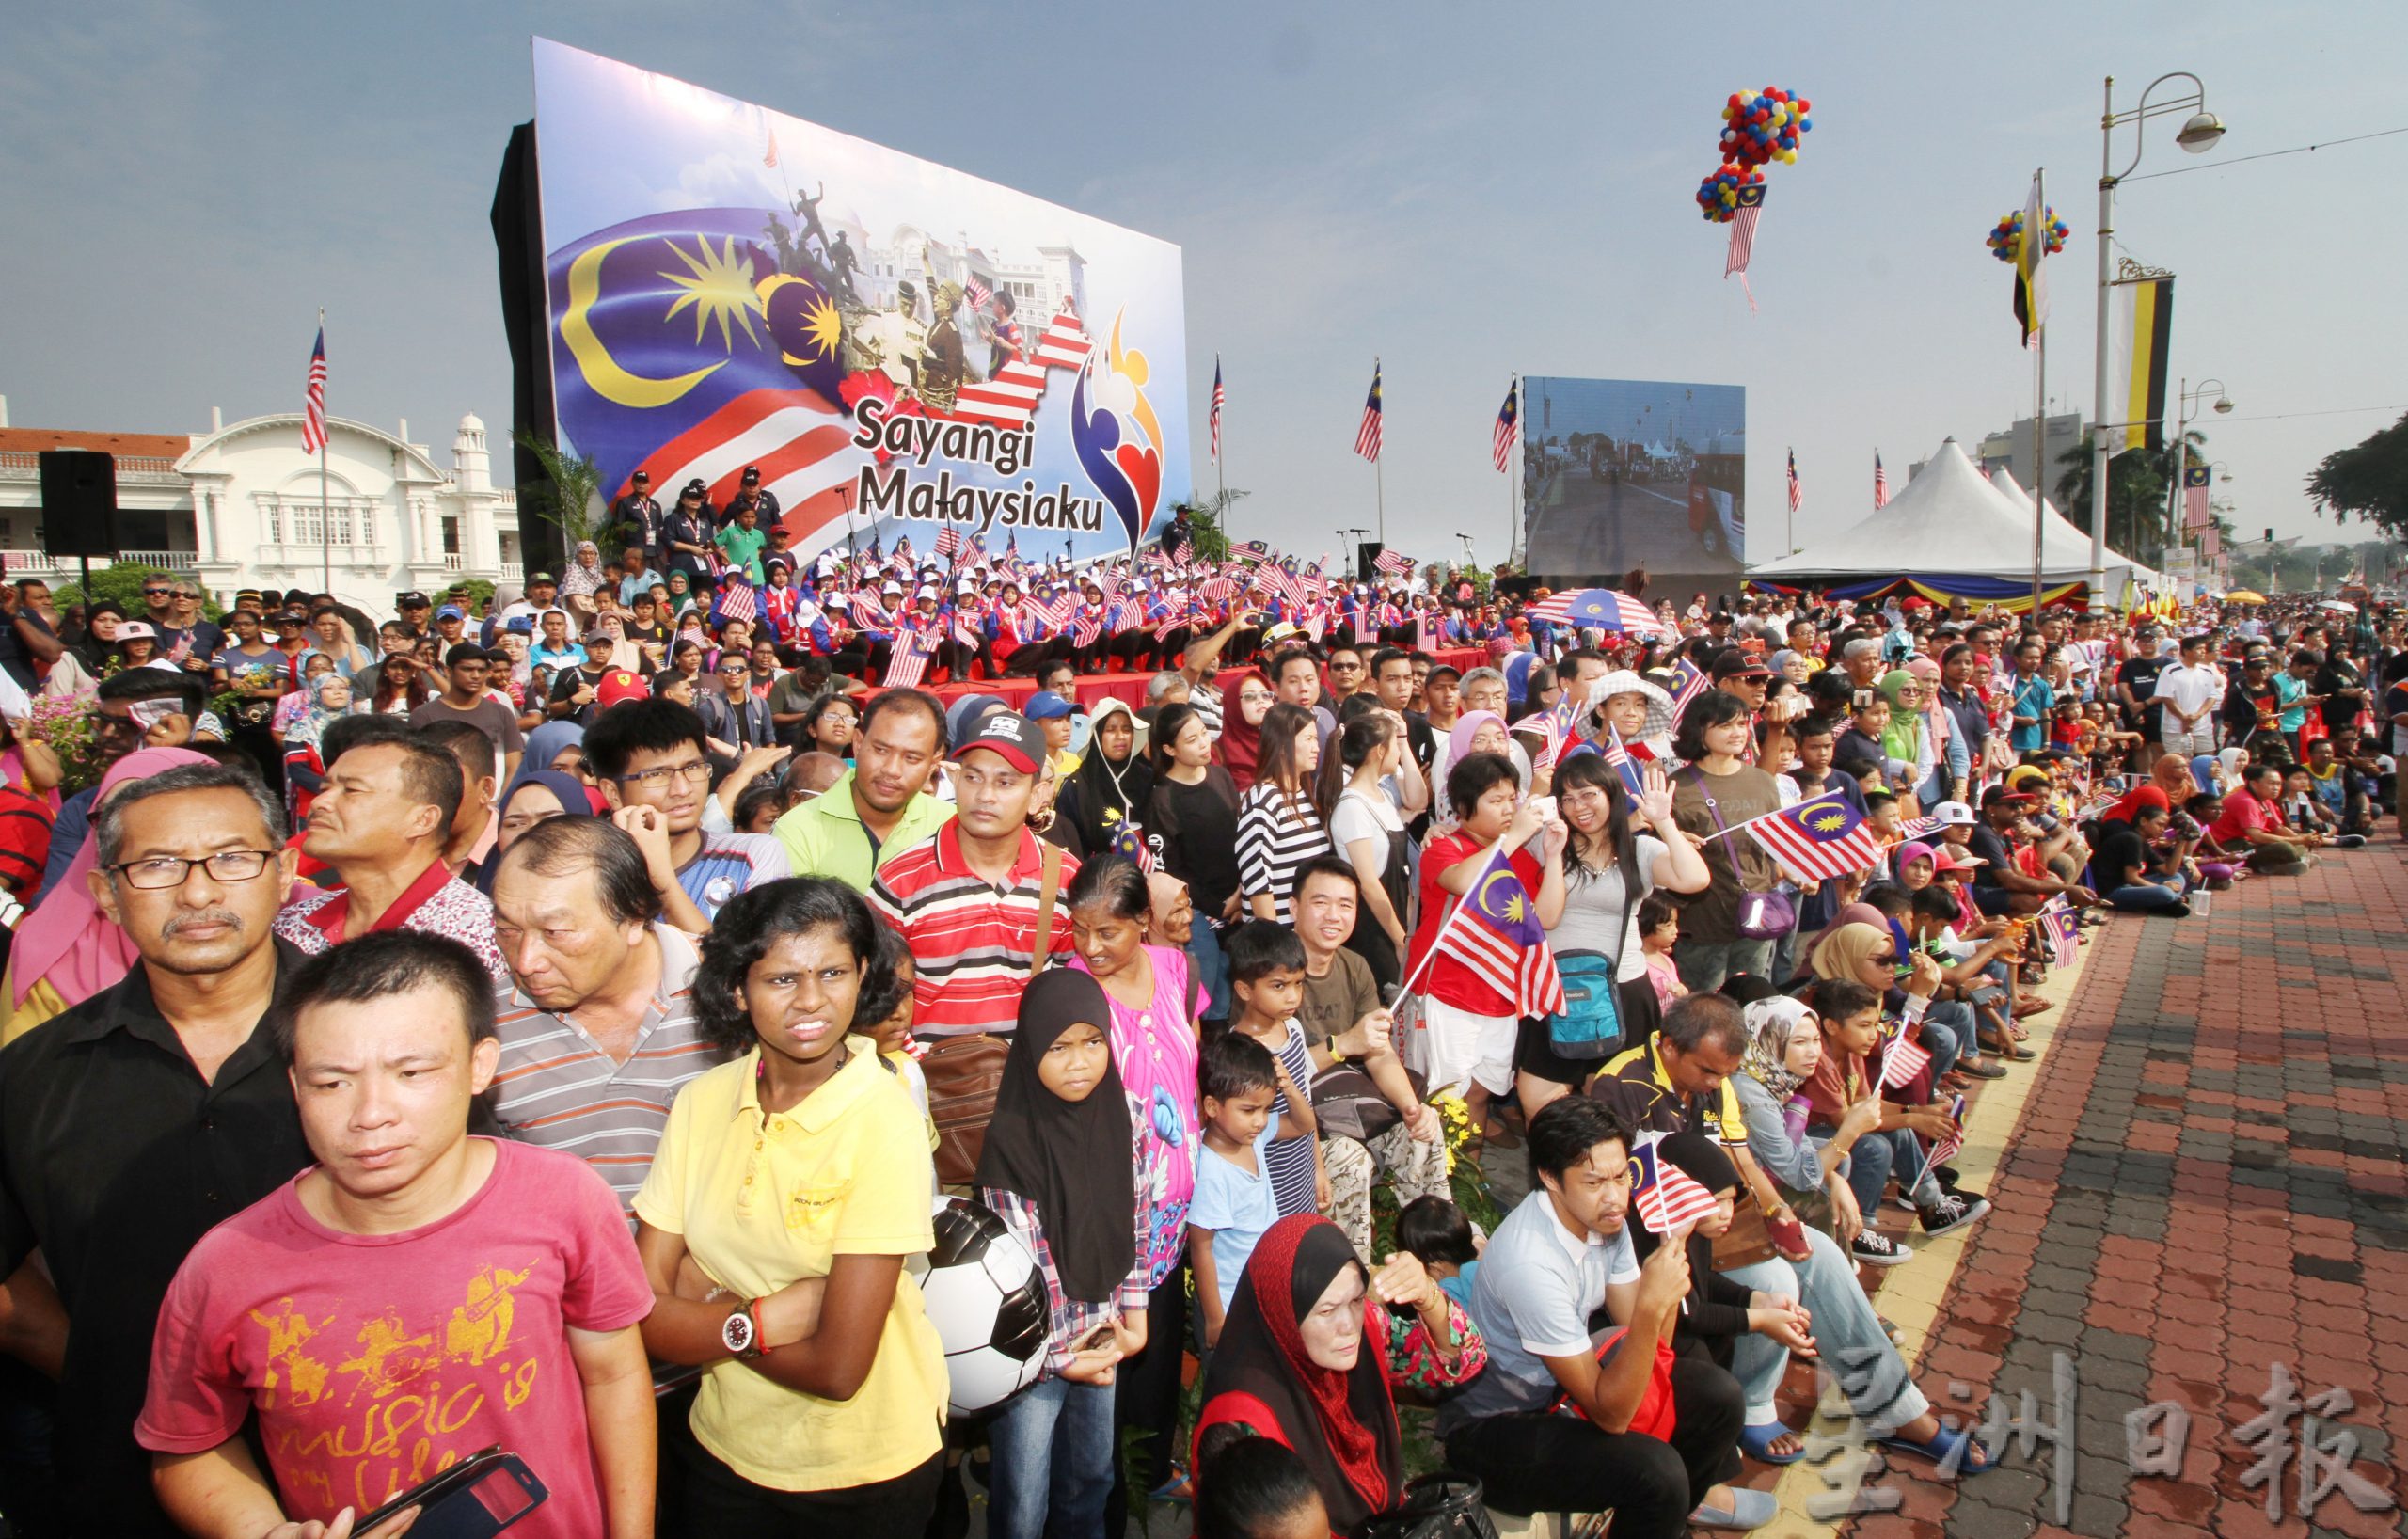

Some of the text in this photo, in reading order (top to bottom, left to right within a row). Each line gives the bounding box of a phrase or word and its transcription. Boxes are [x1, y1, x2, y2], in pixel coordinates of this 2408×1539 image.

[851, 397, 1036, 476] Sayangi
[858, 465, 1104, 533] Malaysiaku
[1720, 799, 1759, 813] ODAY
[499, 1357, 538, 1412] is
